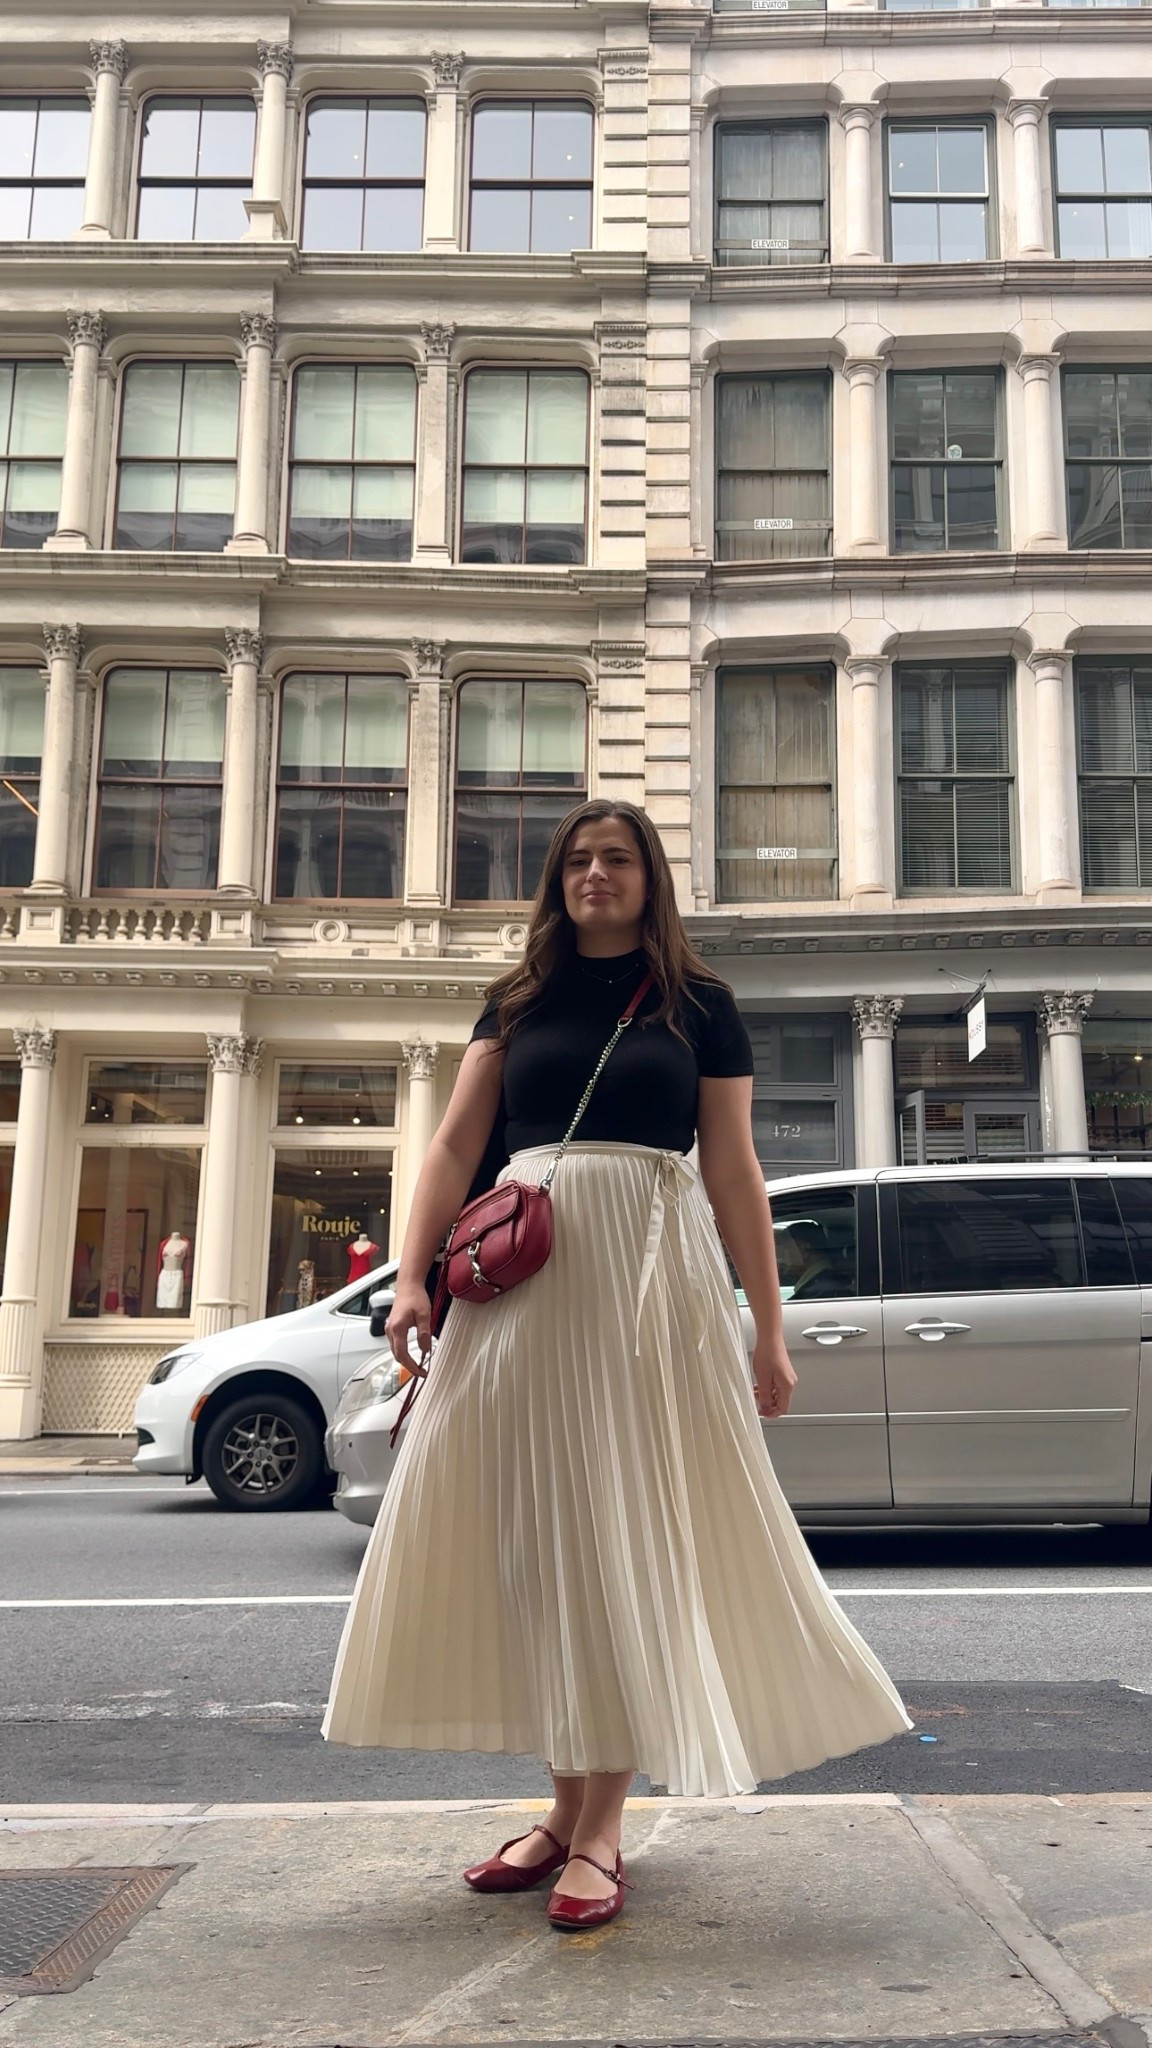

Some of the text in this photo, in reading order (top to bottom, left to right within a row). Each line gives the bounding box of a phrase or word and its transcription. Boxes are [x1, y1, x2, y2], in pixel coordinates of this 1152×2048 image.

[753, 1, 787, 9] ELEVATOR
[752, 240, 788, 248] ELEVATOR
[755, 520, 791, 529] ELEVATOR
[758, 849, 796, 858] ELEVATOR
[771, 1124, 801, 1138] 472
[302, 1214, 361, 1238] Rouje
